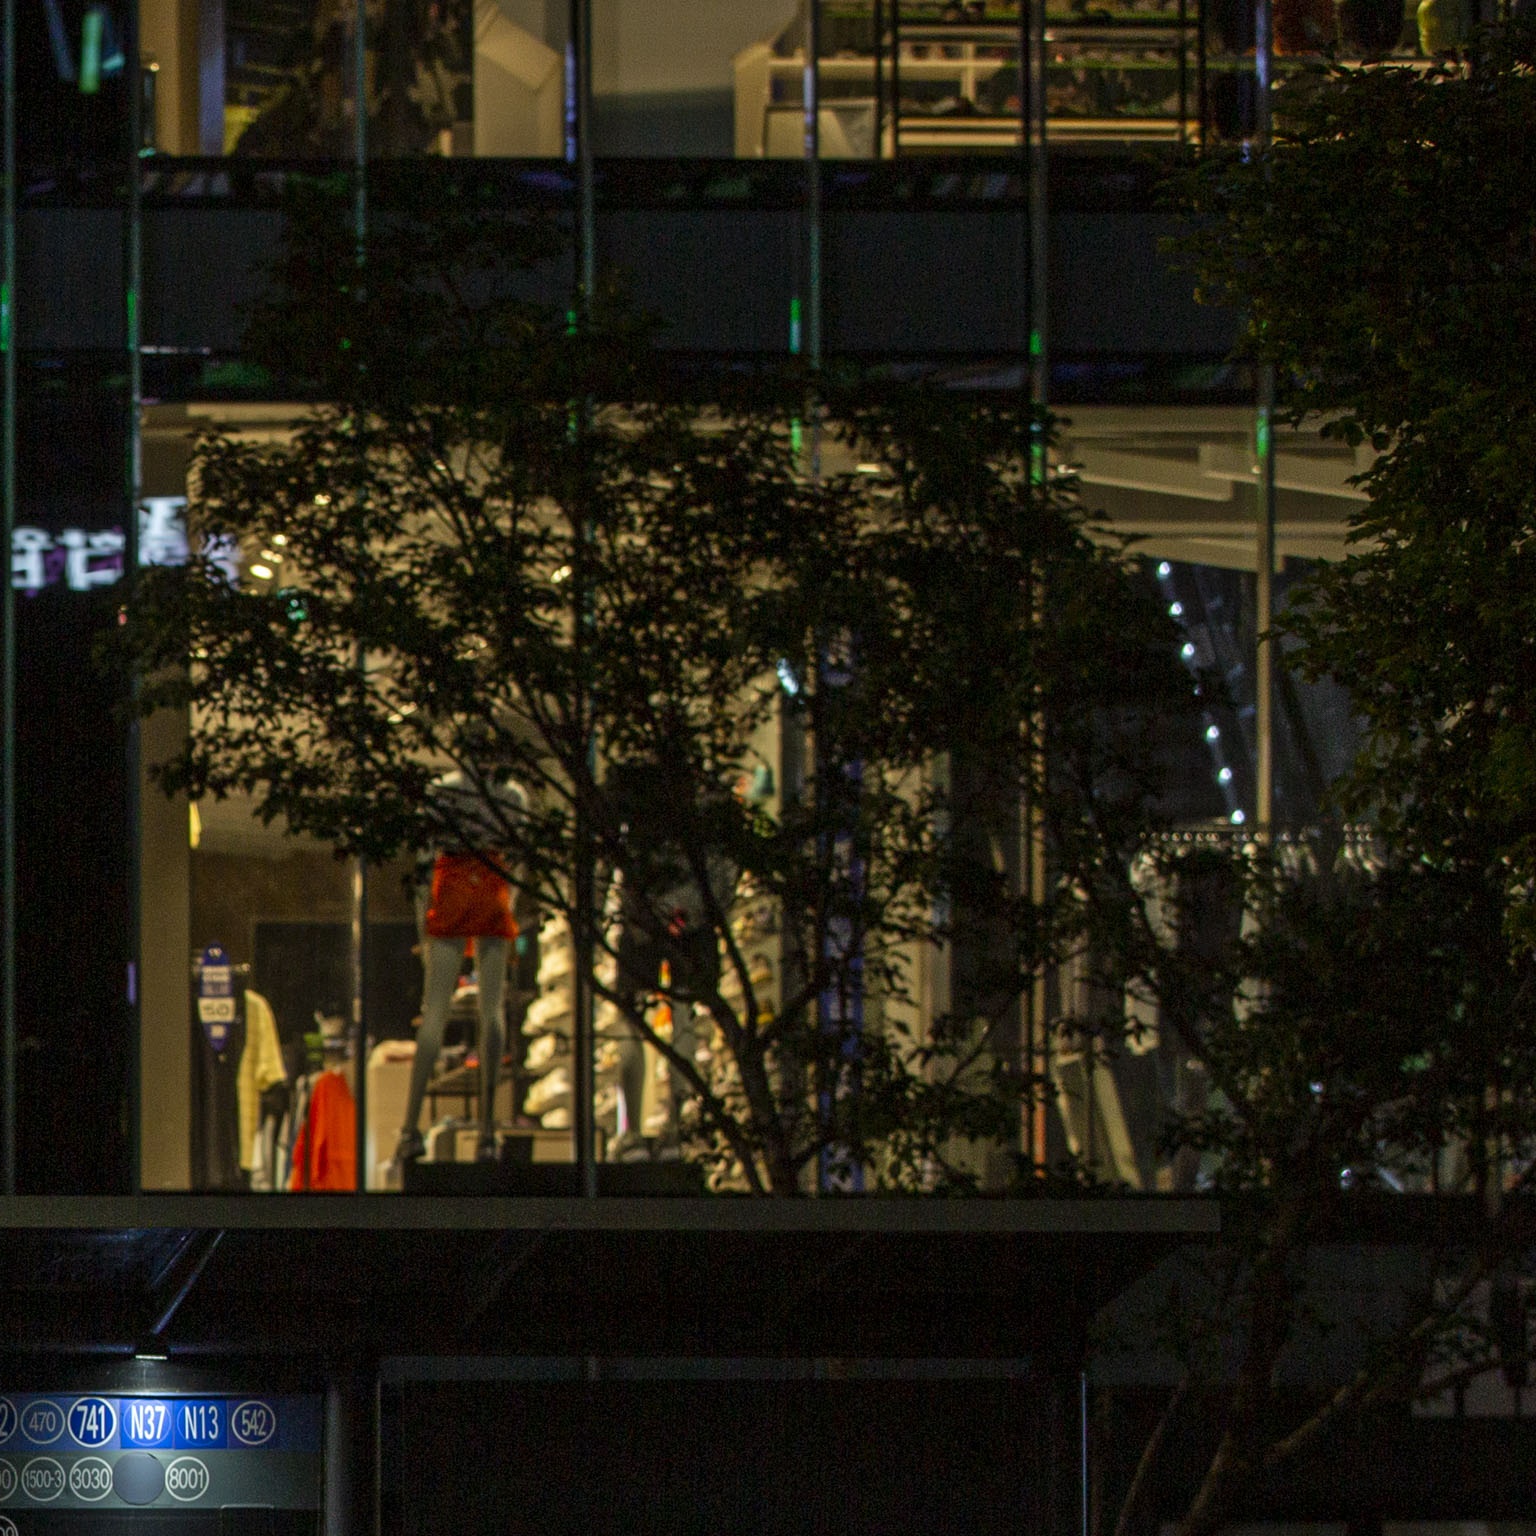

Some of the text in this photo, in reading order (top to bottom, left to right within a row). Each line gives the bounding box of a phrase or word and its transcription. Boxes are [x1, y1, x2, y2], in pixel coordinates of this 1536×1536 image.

[27, 1411, 56, 1432] 470
[77, 1405, 107, 1440] 741
[131, 1402, 165, 1438] N37
[185, 1404, 219, 1438] N13
[241, 1410, 267, 1435] 542
[74, 1468, 110, 1490] 3030
[170, 1468, 205, 1490] 8001
